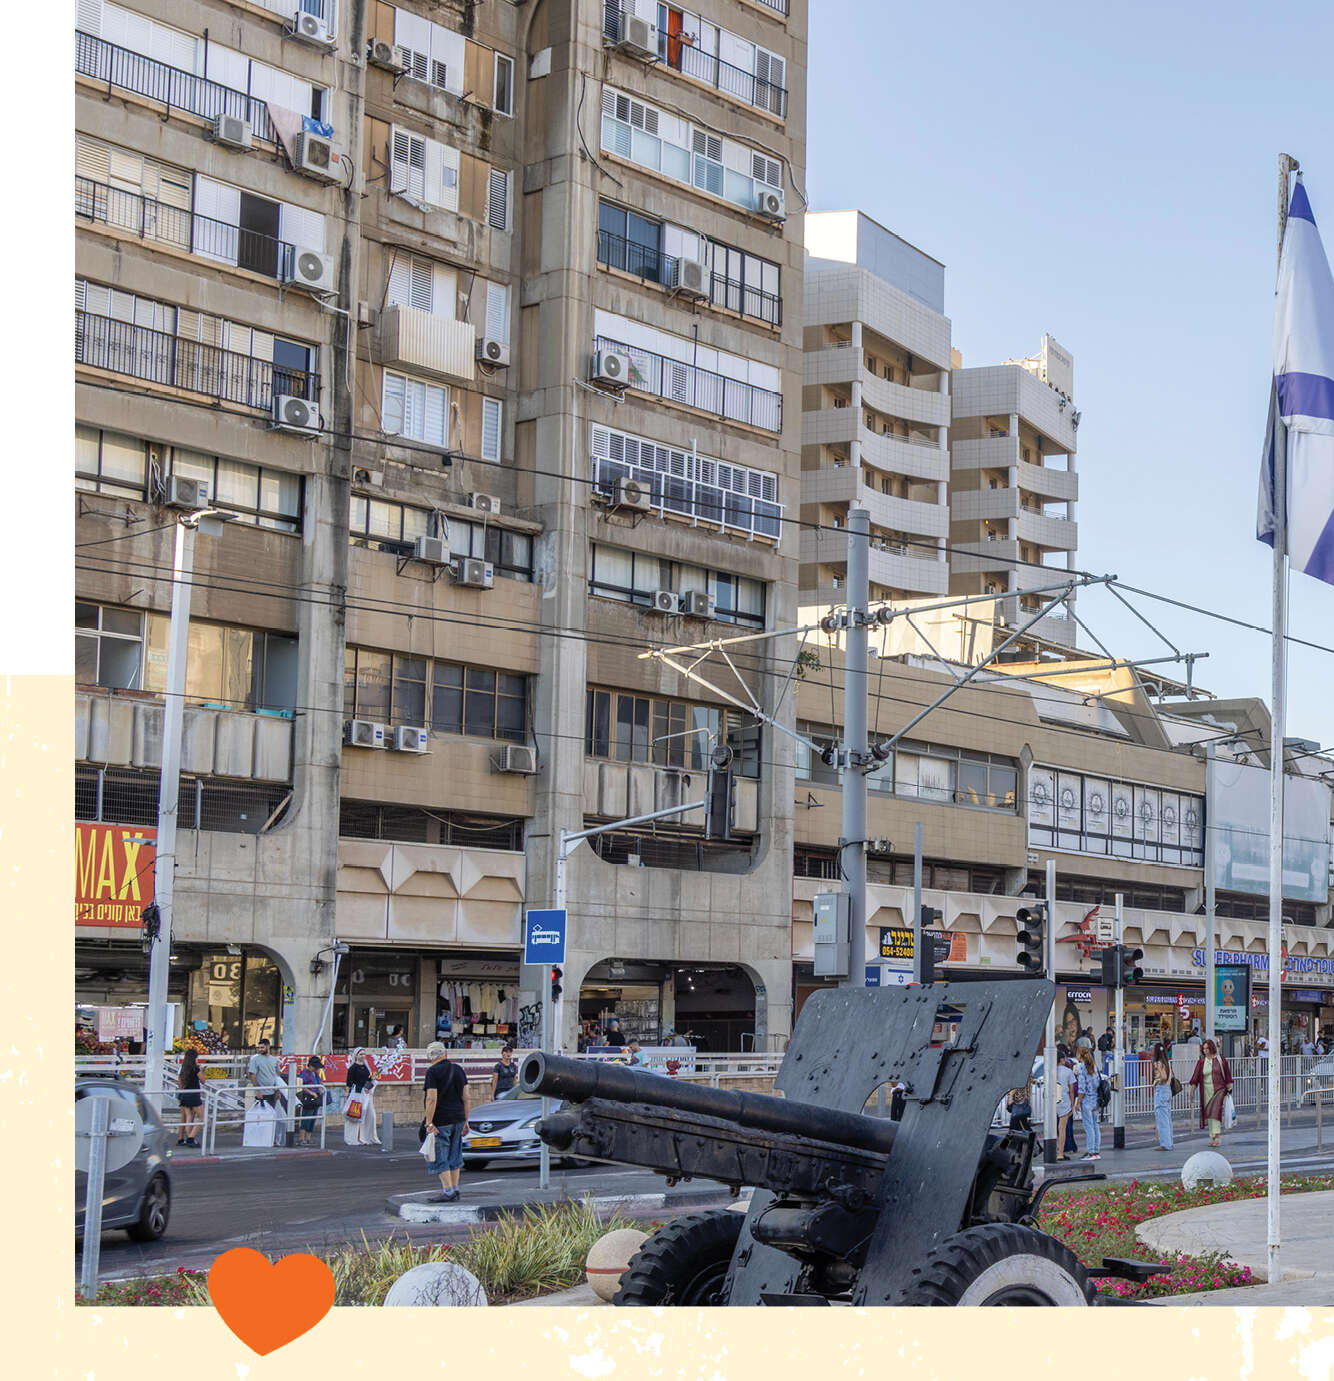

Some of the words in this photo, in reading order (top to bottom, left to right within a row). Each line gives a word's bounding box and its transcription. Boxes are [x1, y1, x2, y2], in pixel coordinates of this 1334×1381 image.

[75, 827, 143, 901] MAX
[97, 904, 122, 923] קונים
[125, 905, 141, 923] כאן
[1193, 949, 1269, 970] SUER-PHARM
